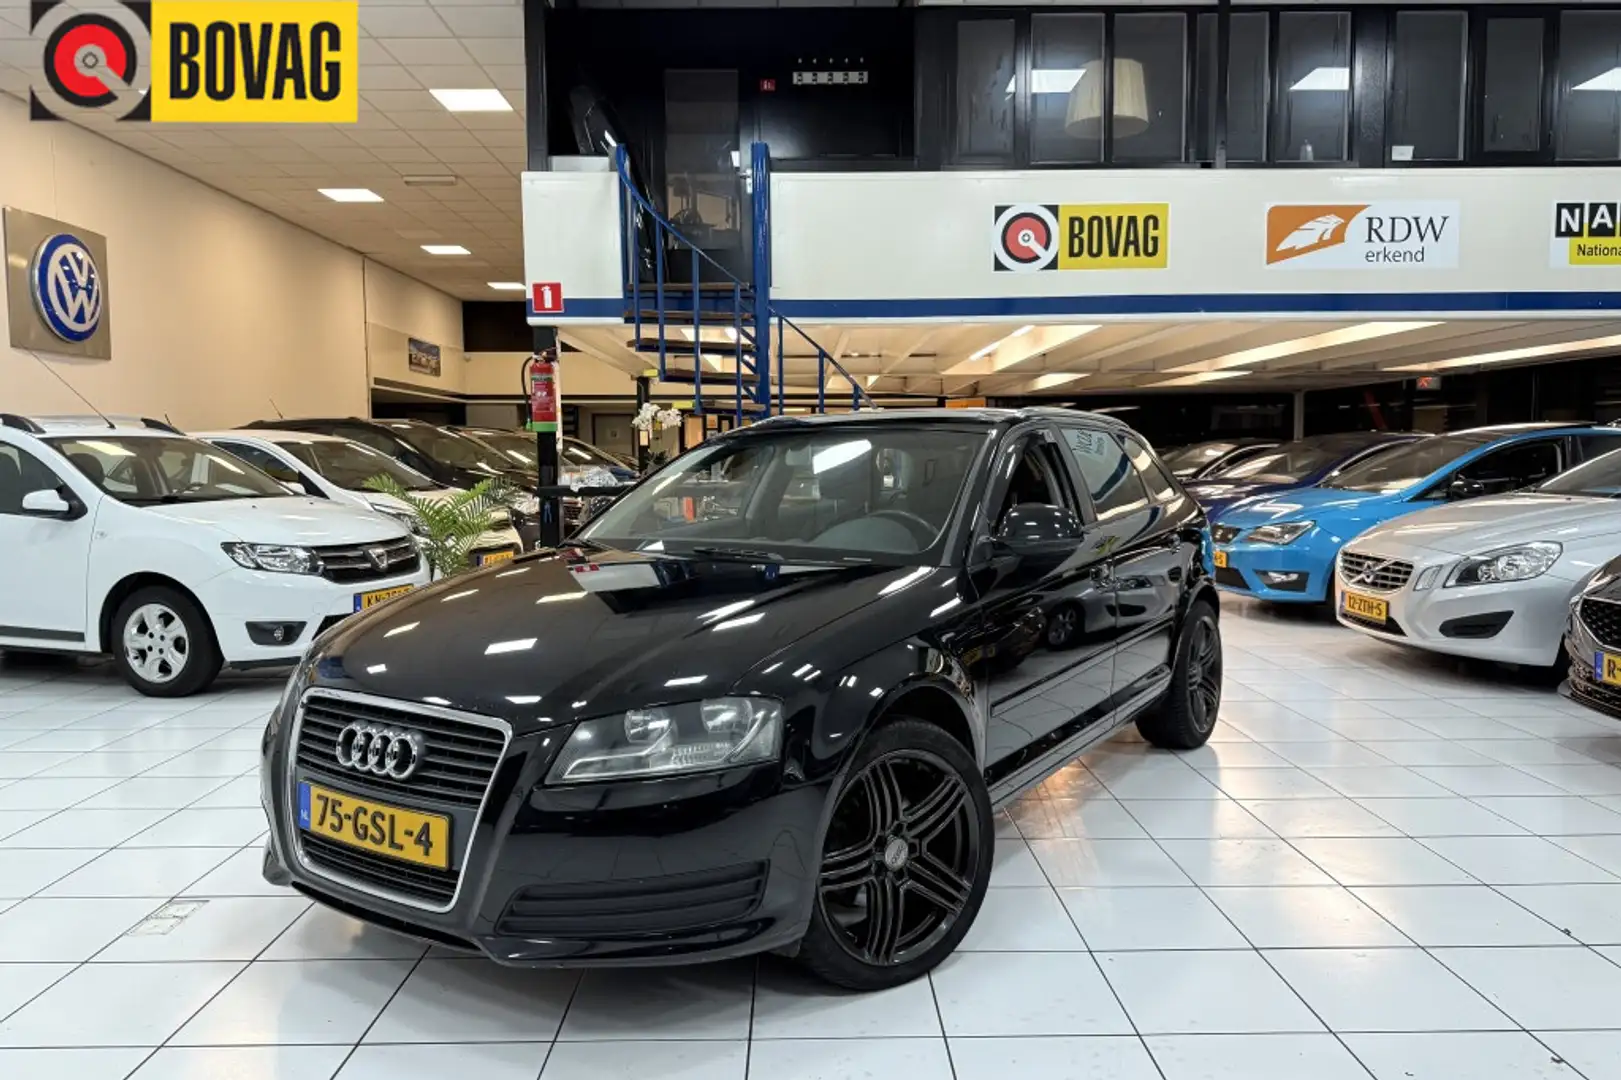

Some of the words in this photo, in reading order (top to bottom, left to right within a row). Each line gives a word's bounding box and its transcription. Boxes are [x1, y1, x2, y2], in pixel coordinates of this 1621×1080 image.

[1068, 214, 1159, 258] BOVAG
[1364, 215, 1450, 243] RDW
[1364, 246, 1425, 263] erkend
[316, 794, 433, 857] 75-GSL-4
